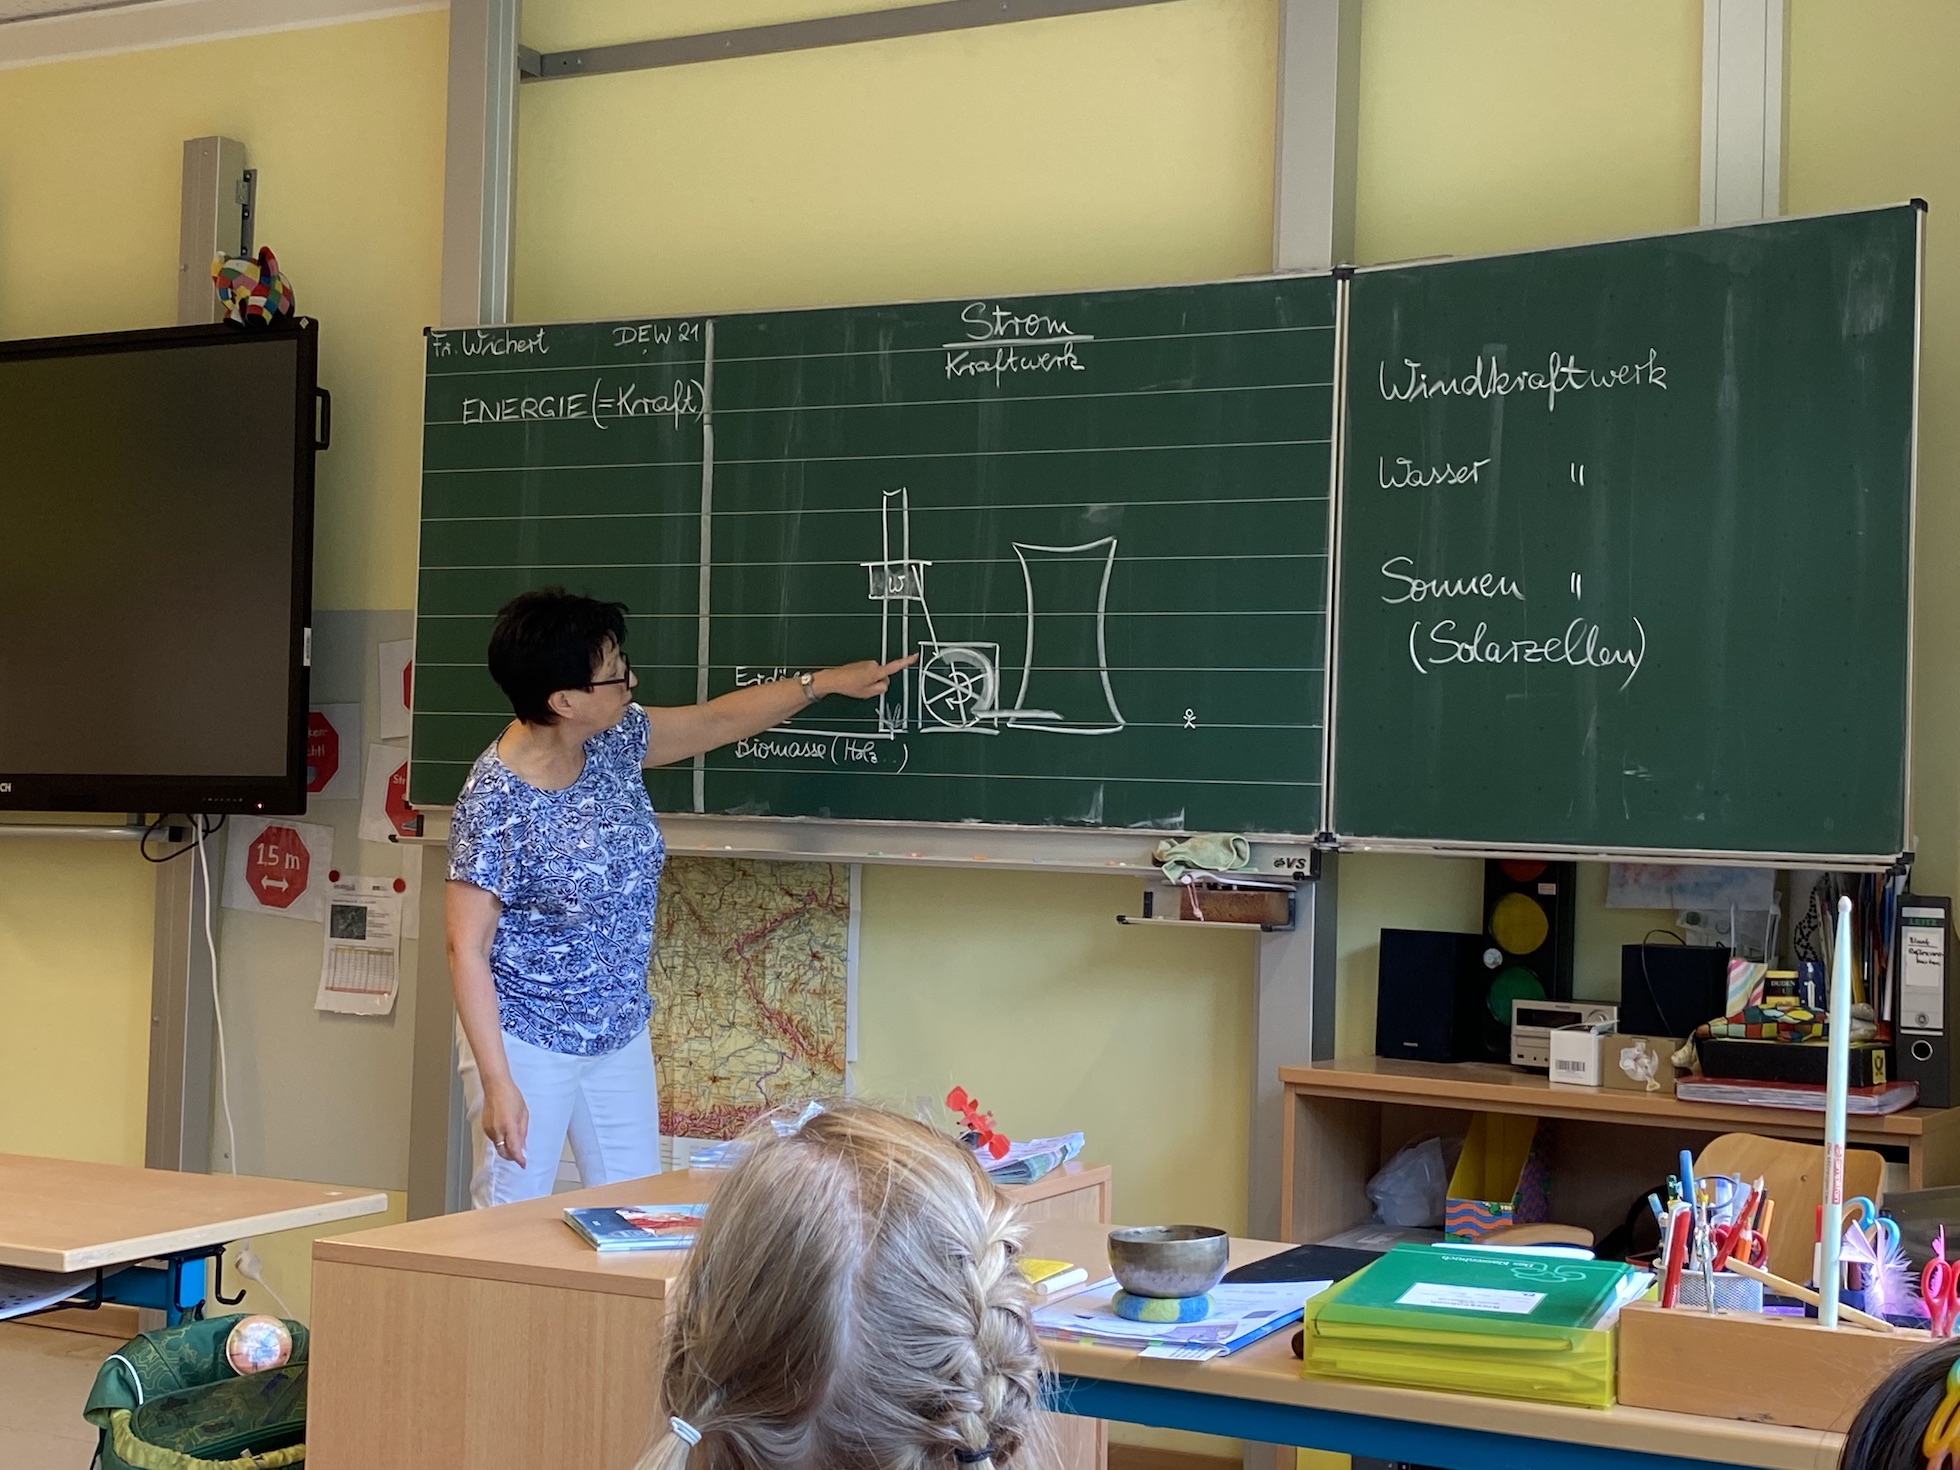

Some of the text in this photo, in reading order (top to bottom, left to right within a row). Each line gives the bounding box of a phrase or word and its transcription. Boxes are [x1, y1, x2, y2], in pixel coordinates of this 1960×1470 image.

[961, 302, 1074, 340] Strom
[462, 329, 550, 356] Wichert
[945, 341, 1085, 388] Kraftwerk
[1379, 348, 1667, 412] Windkraftwerk
[462, 393, 588, 425] ENERGIE
[1379, 456, 1491, 488] Wasser
[1381, 556, 1527, 604] Sonnen
[1409, 617, 1645, 693] (Solarzellen)
[284, 853, 300, 870] m
